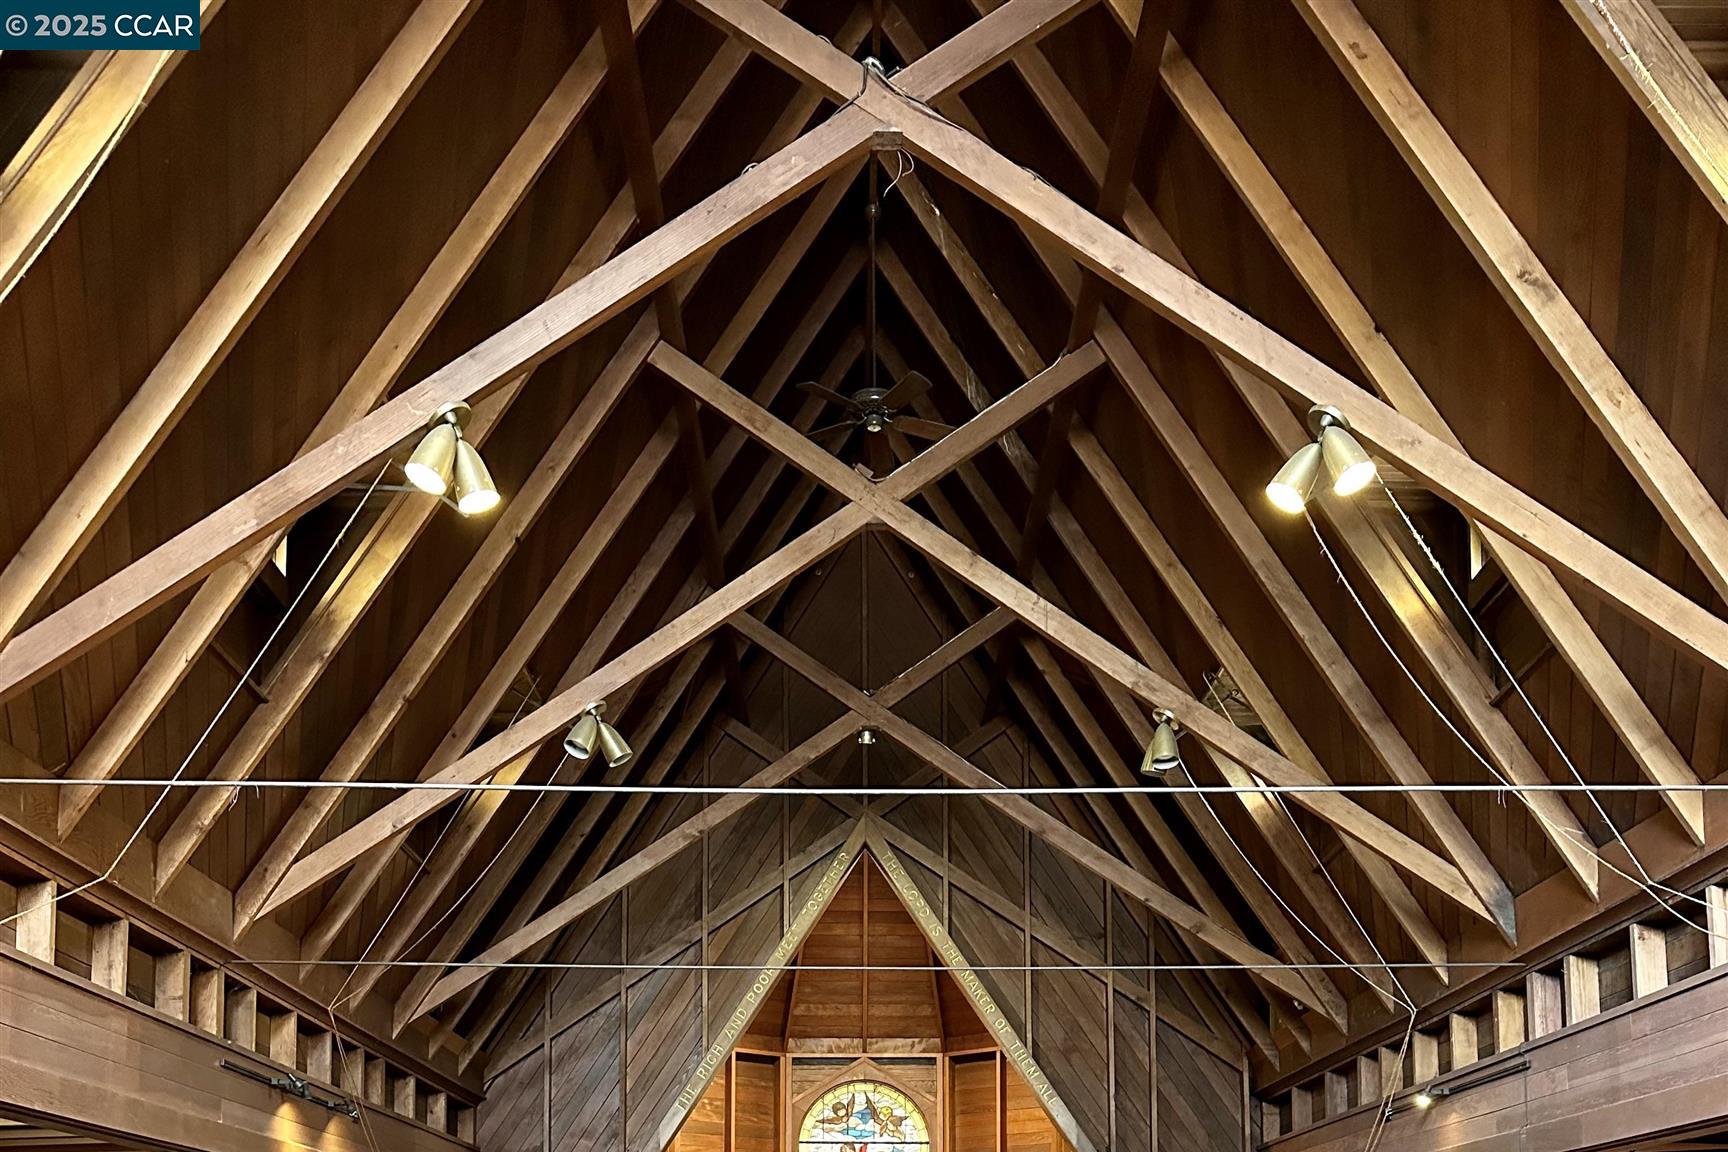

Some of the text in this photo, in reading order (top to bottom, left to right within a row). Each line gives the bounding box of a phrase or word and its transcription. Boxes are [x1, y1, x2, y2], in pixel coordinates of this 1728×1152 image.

[675, 1083, 698, 1111] THE
[696, 1043, 724, 1080] RICH
[724, 1008, 747, 1040] AND
[775, 923, 798, 960] MEET
[802, 852, 850, 916] TOGETHER
[881, 851, 1059, 1106] THE LORD IS THE MAKER OF THEM ALL
